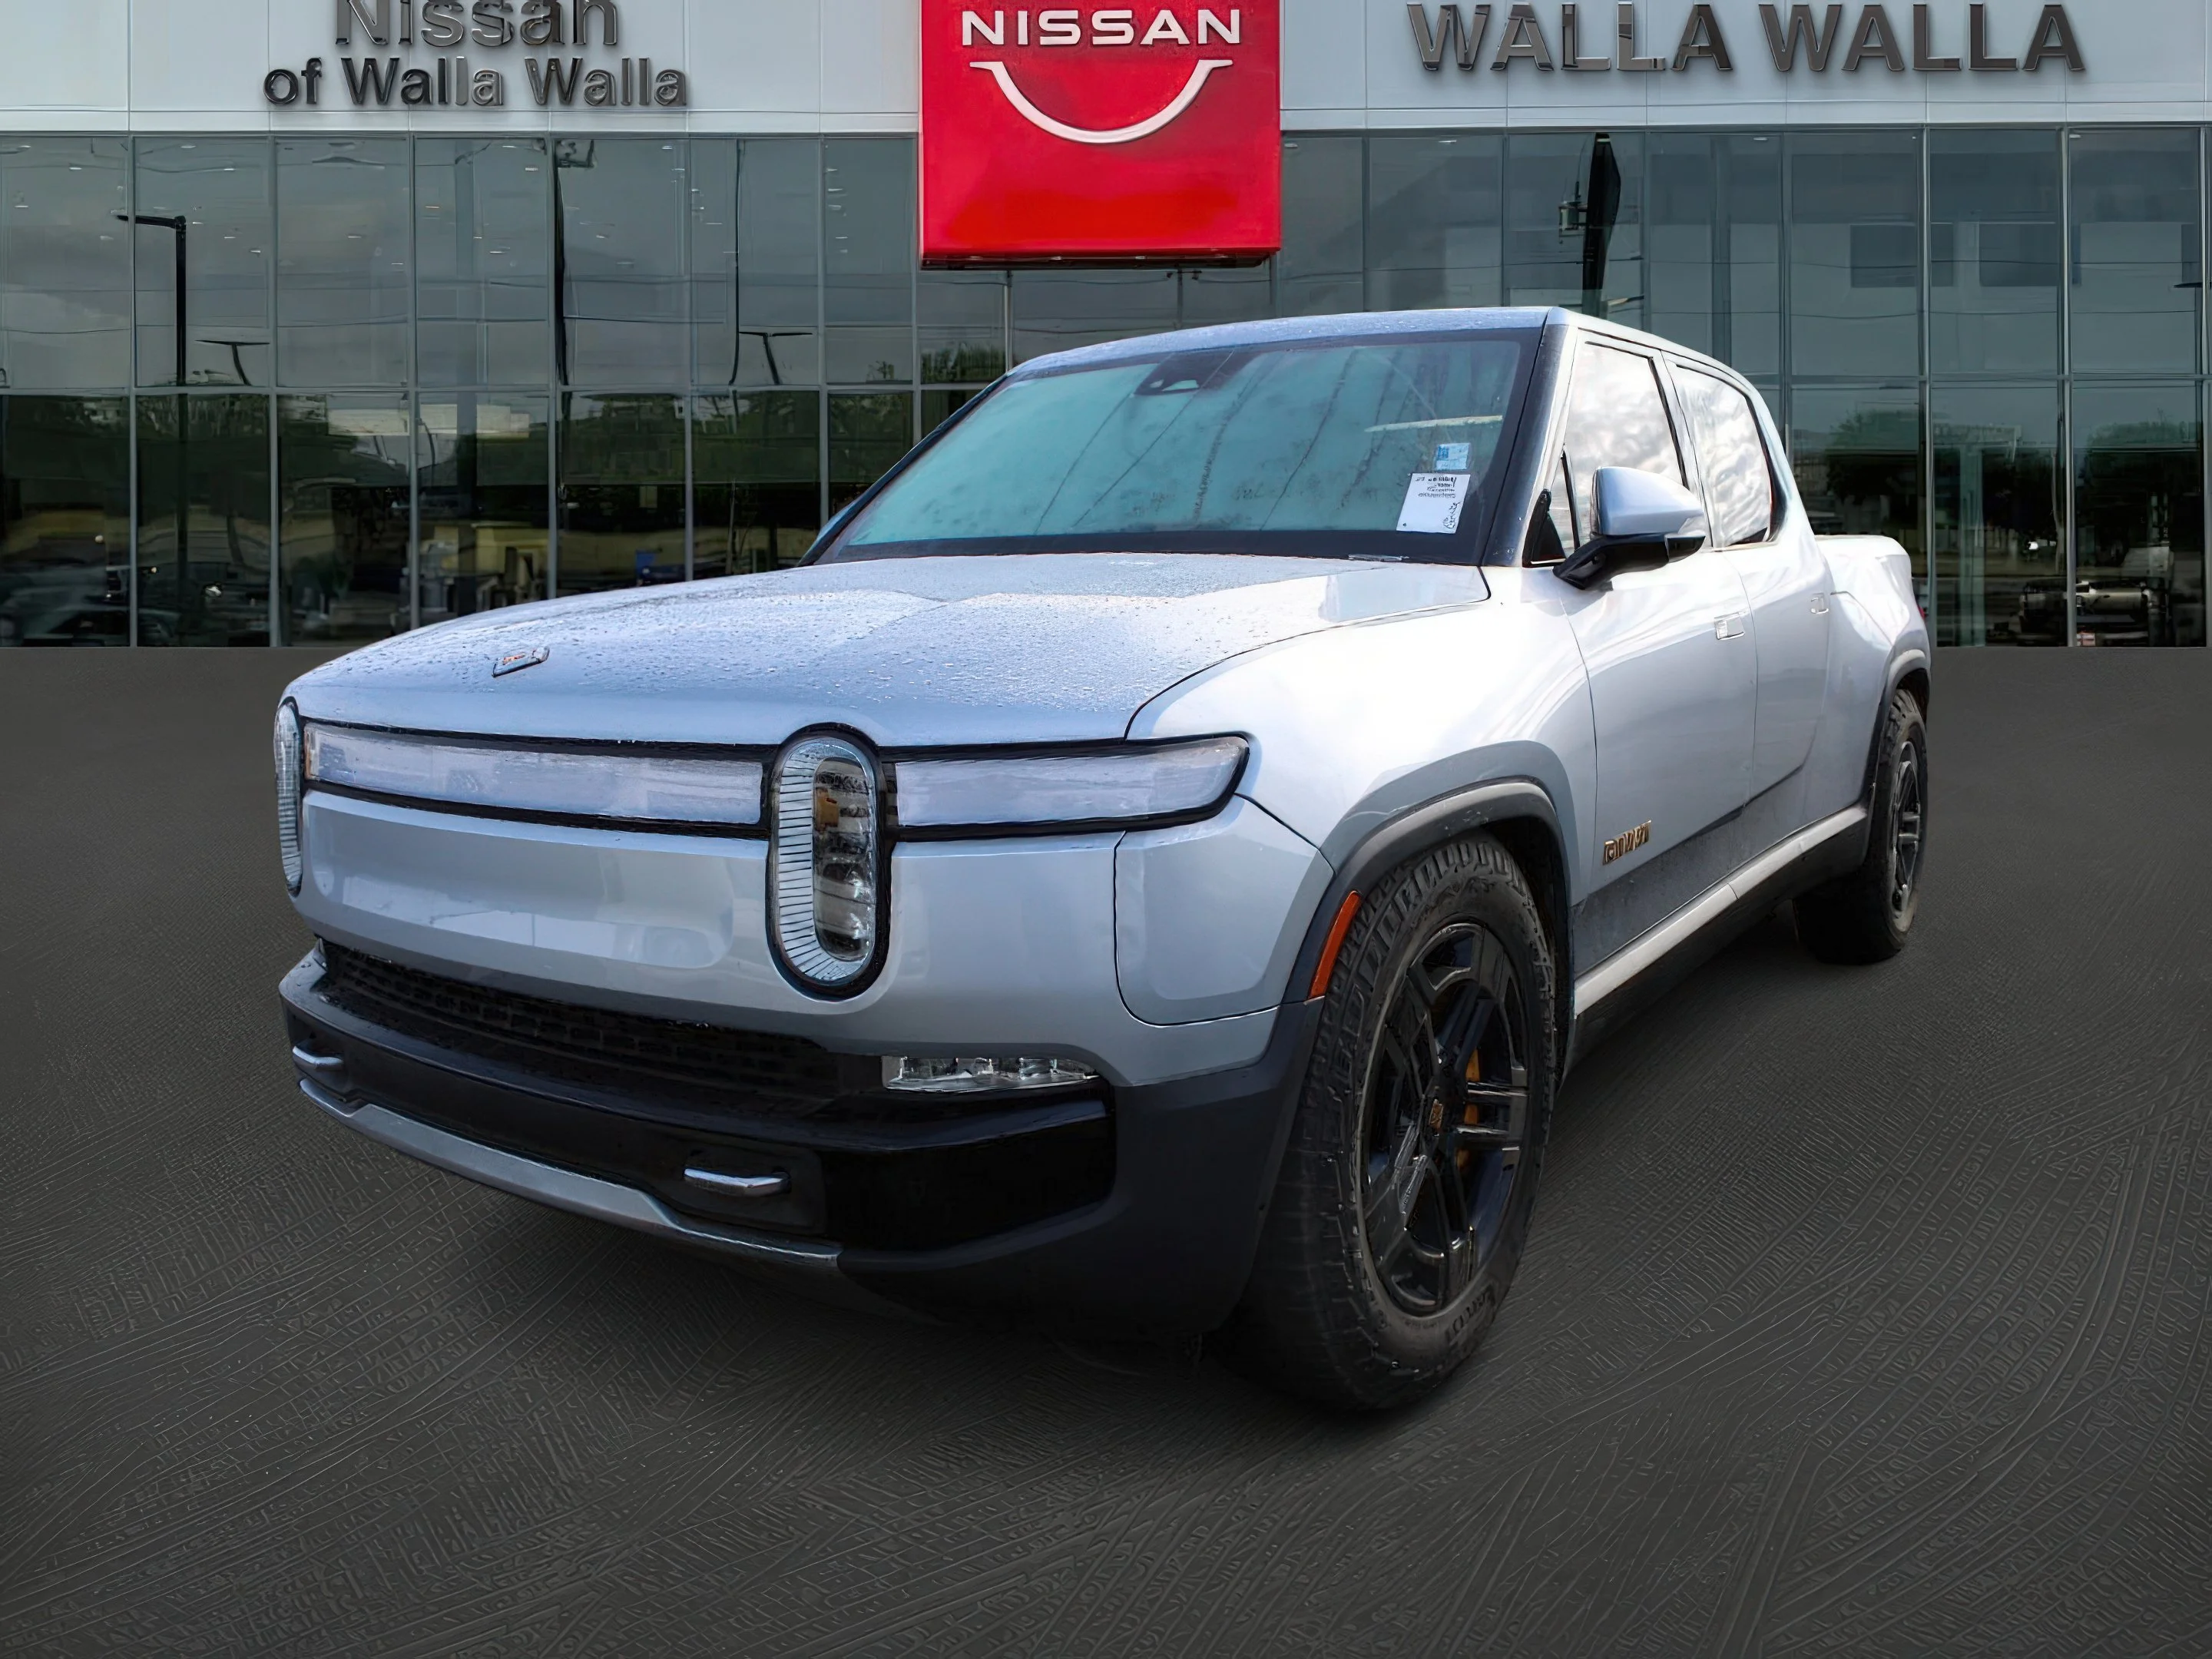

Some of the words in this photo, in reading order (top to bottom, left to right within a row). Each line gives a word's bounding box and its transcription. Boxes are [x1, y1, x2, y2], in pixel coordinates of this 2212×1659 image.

[336, 0, 618, 47] Nissan
[962, 9, 1240, 46] NISSAN
[1406, 2, 1734, 71] WALLA
[1758, 3, 2086, 72] WALLA
[263, 57, 323, 105] of
[340, 57, 504, 106] Walla
[524, 57, 687, 106] Walla
